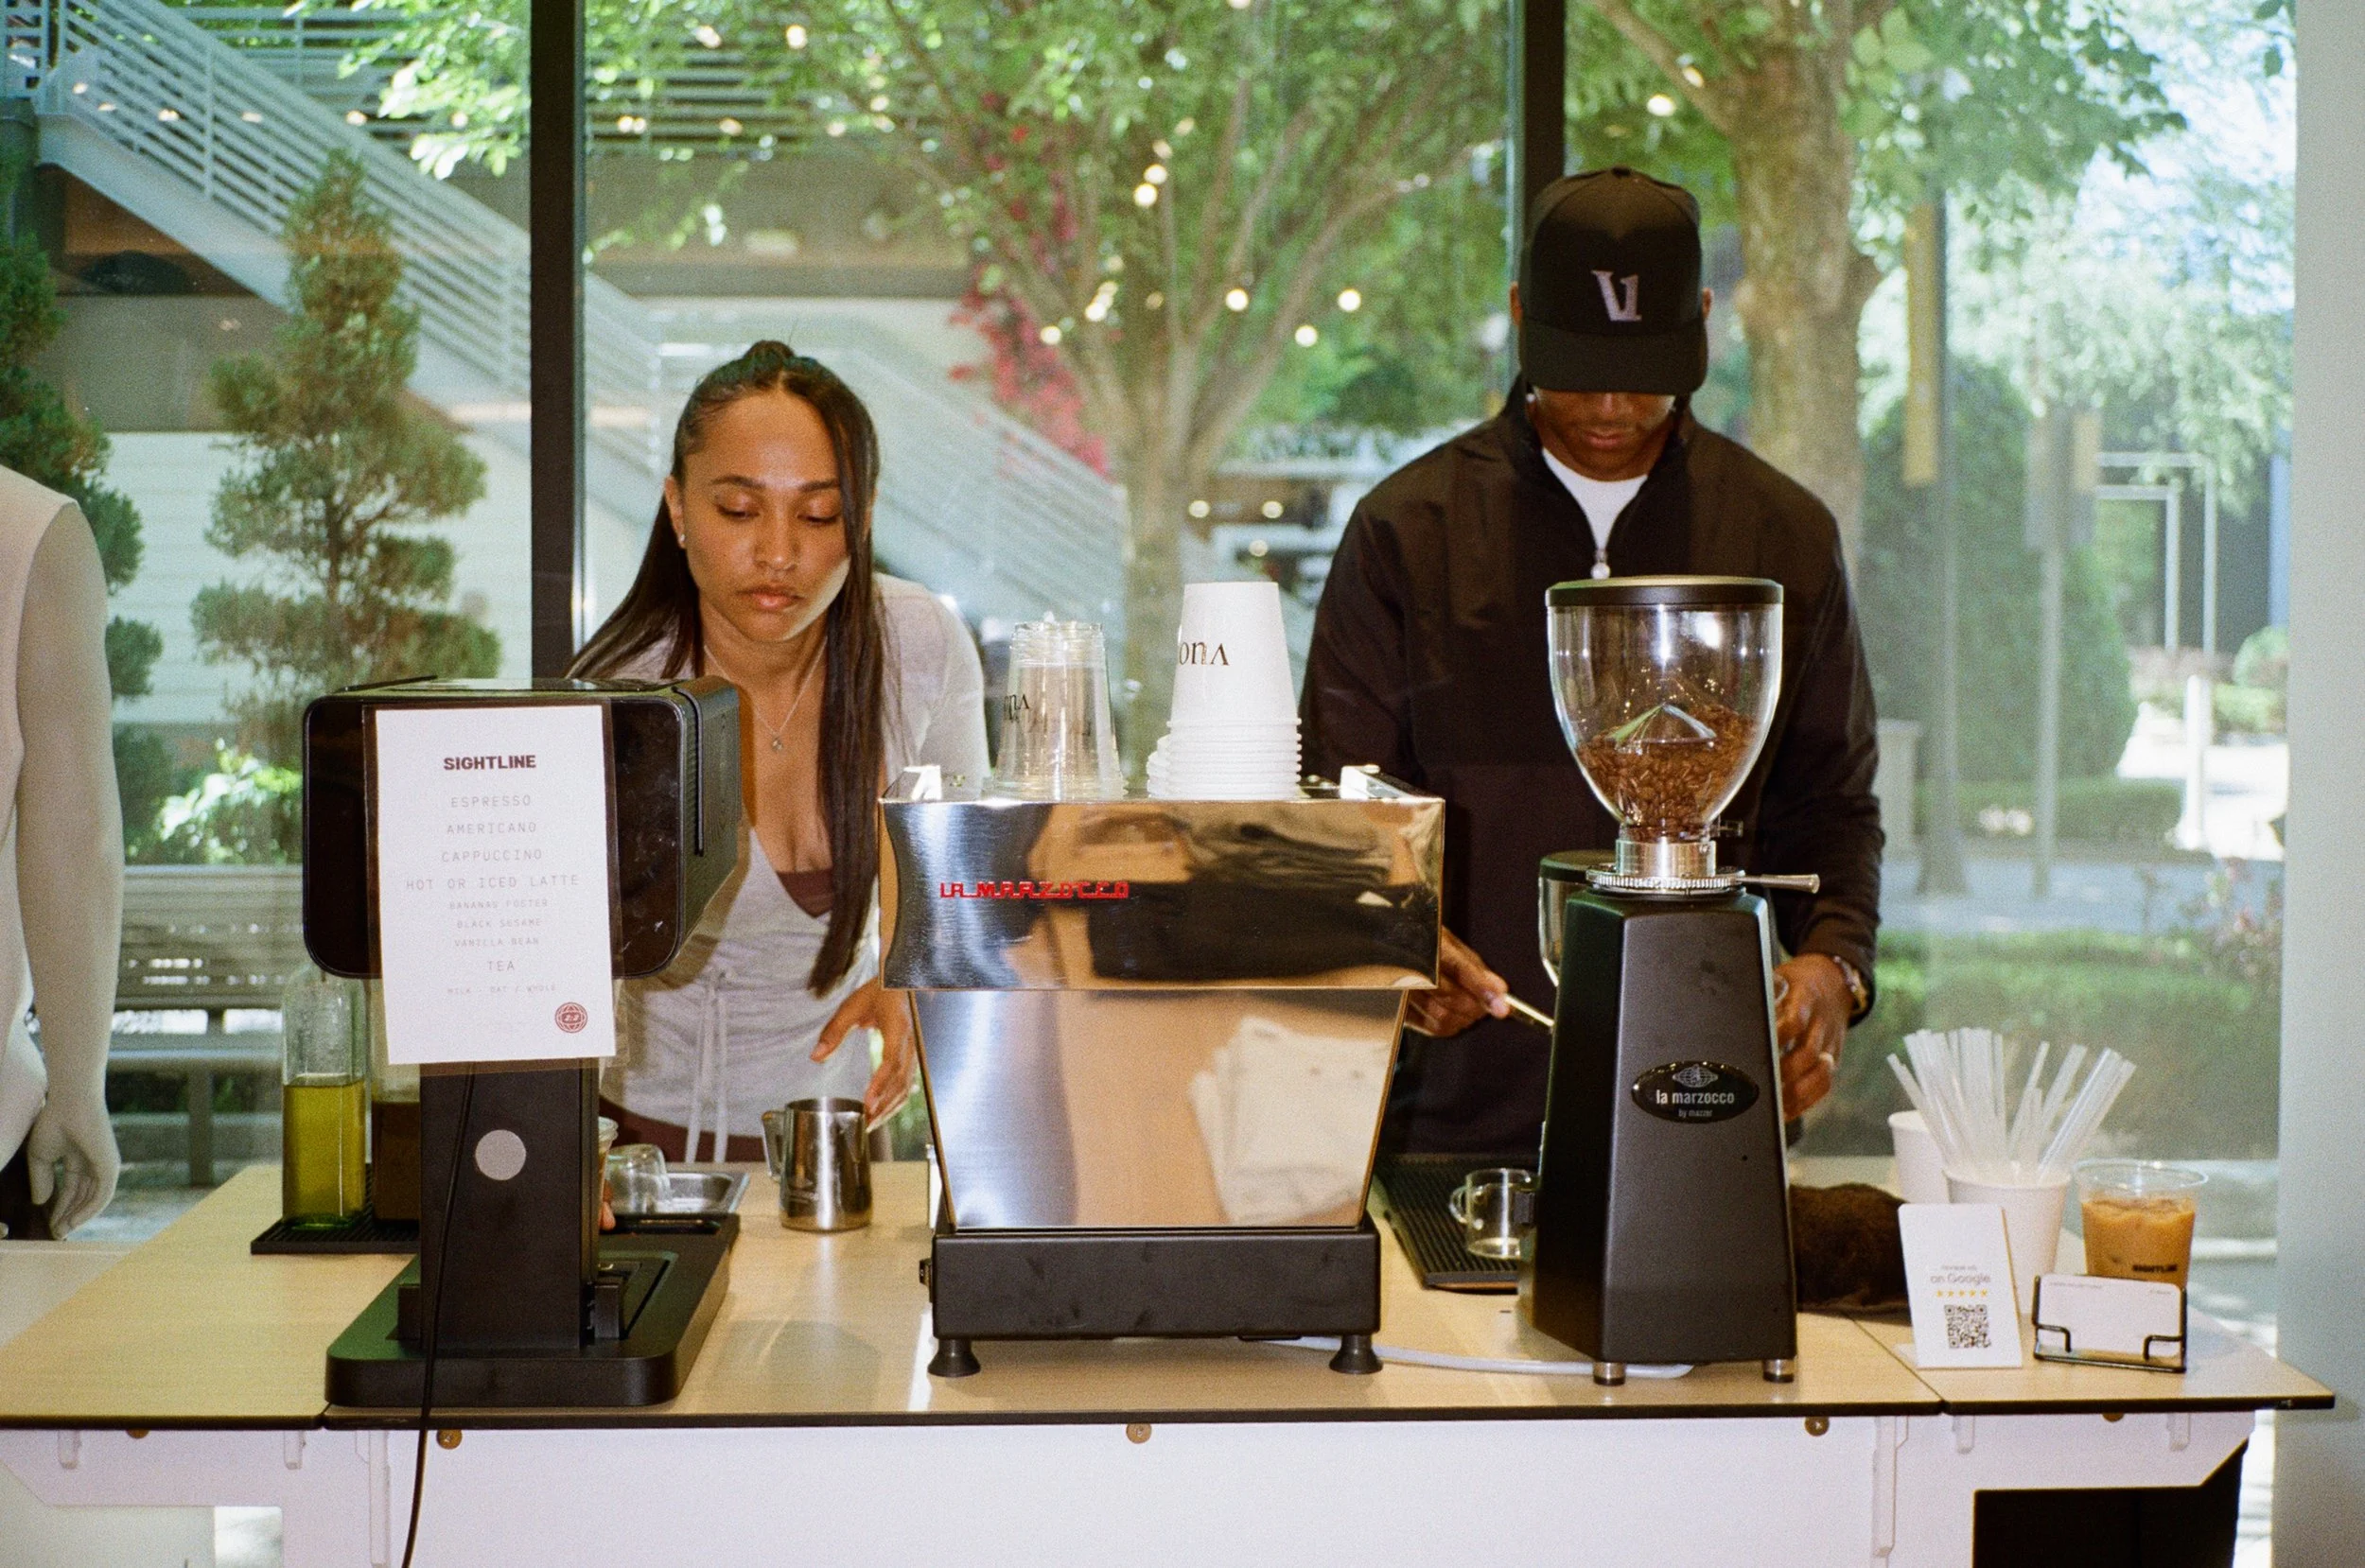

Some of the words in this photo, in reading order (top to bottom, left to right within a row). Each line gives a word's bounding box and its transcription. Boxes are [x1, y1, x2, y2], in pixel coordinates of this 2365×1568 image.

[443, 754, 536, 771] SIGHTLINE
[450, 794, 532, 809] ESPRESSO
[447, 822, 537, 835] AMERICANO
[441, 848, 543, 862] CAPPUCCINO
[406, 878, 433, 890] HOT
[447, 877, 465, 889] OR
[479, 876, 517, 888] ICED
[530, 874, 579, 887] LATTE
[977, 881, 1129, 898] MARZOCCO
[448, 900, 499, 910] BANANAS
[505, 898, 548, 908] FOSTER
[456, 919, 492, 929] BLACK
[499, 918, 542, 928] SESAME
[454, 937, 503, 947] VANILLA
[511, 936, 539, 946] BEAN
[487, 960, 516, 971] TEA
[1656, 1089, 1668, 1105] la
[1672, 1092, 1735, 1105] marzocco
[1678, 1108, 1687, 1119] by
[1930, 1275, 1945, 1283] on
[1947, 1272, 1991, 1286] Google
